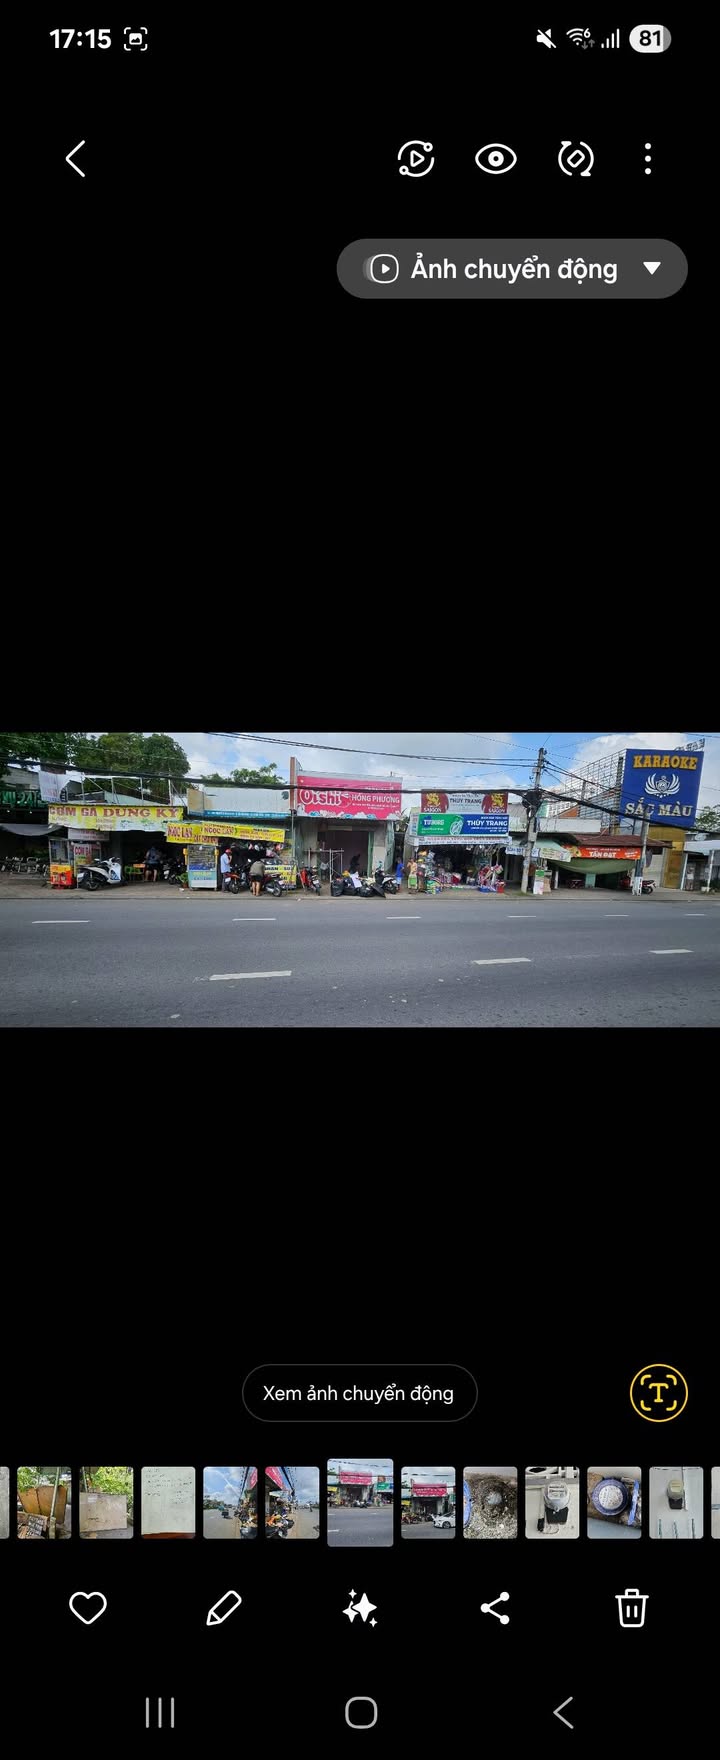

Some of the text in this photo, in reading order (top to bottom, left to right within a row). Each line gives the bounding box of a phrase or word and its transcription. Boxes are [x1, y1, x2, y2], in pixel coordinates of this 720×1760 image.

[50, 28, 112, 50] 17:15
[583, 28, 591, 39] 6
[639, 29, 661, 47] 81
[411, 253, 618, 285] Ảnh chuyển động
[633, 755, 698, 770] KARAOKE
[658, 801, 694, 816] MÀU
[264, 1382, 454, 1405] Xem ảnh chuyển động
[648, 1382, 669, 1403] T
